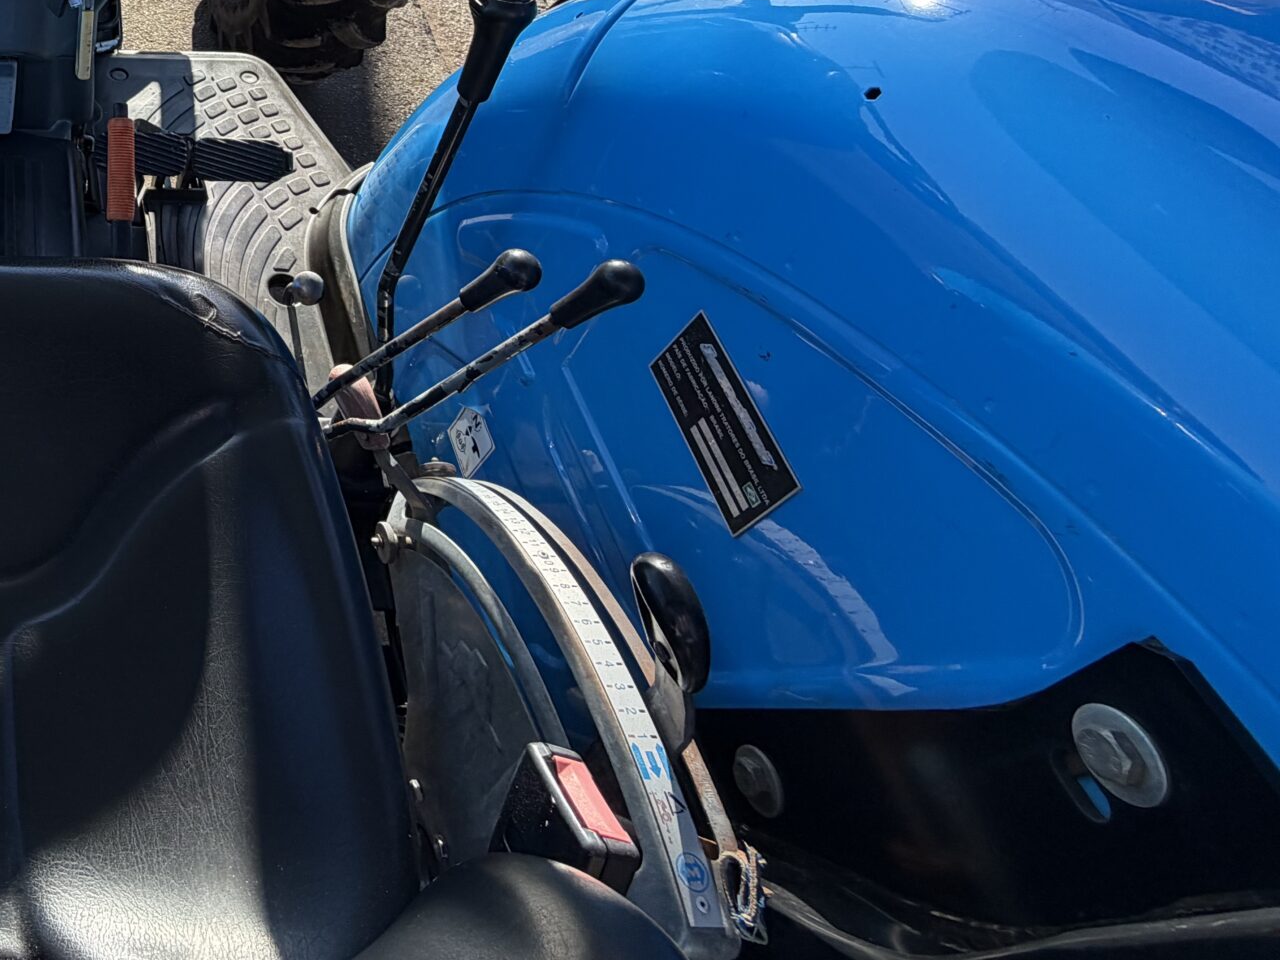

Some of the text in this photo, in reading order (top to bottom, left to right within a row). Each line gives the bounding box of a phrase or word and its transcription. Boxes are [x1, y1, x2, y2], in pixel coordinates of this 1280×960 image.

[709, 414, 723, 439] BRASIL
[719, 412, 739, 447] TRATORES
[737, 447, 745, 459] DO
[743, 459, 759, 485] BRASIL
[625, 707, 638, 715] 2
